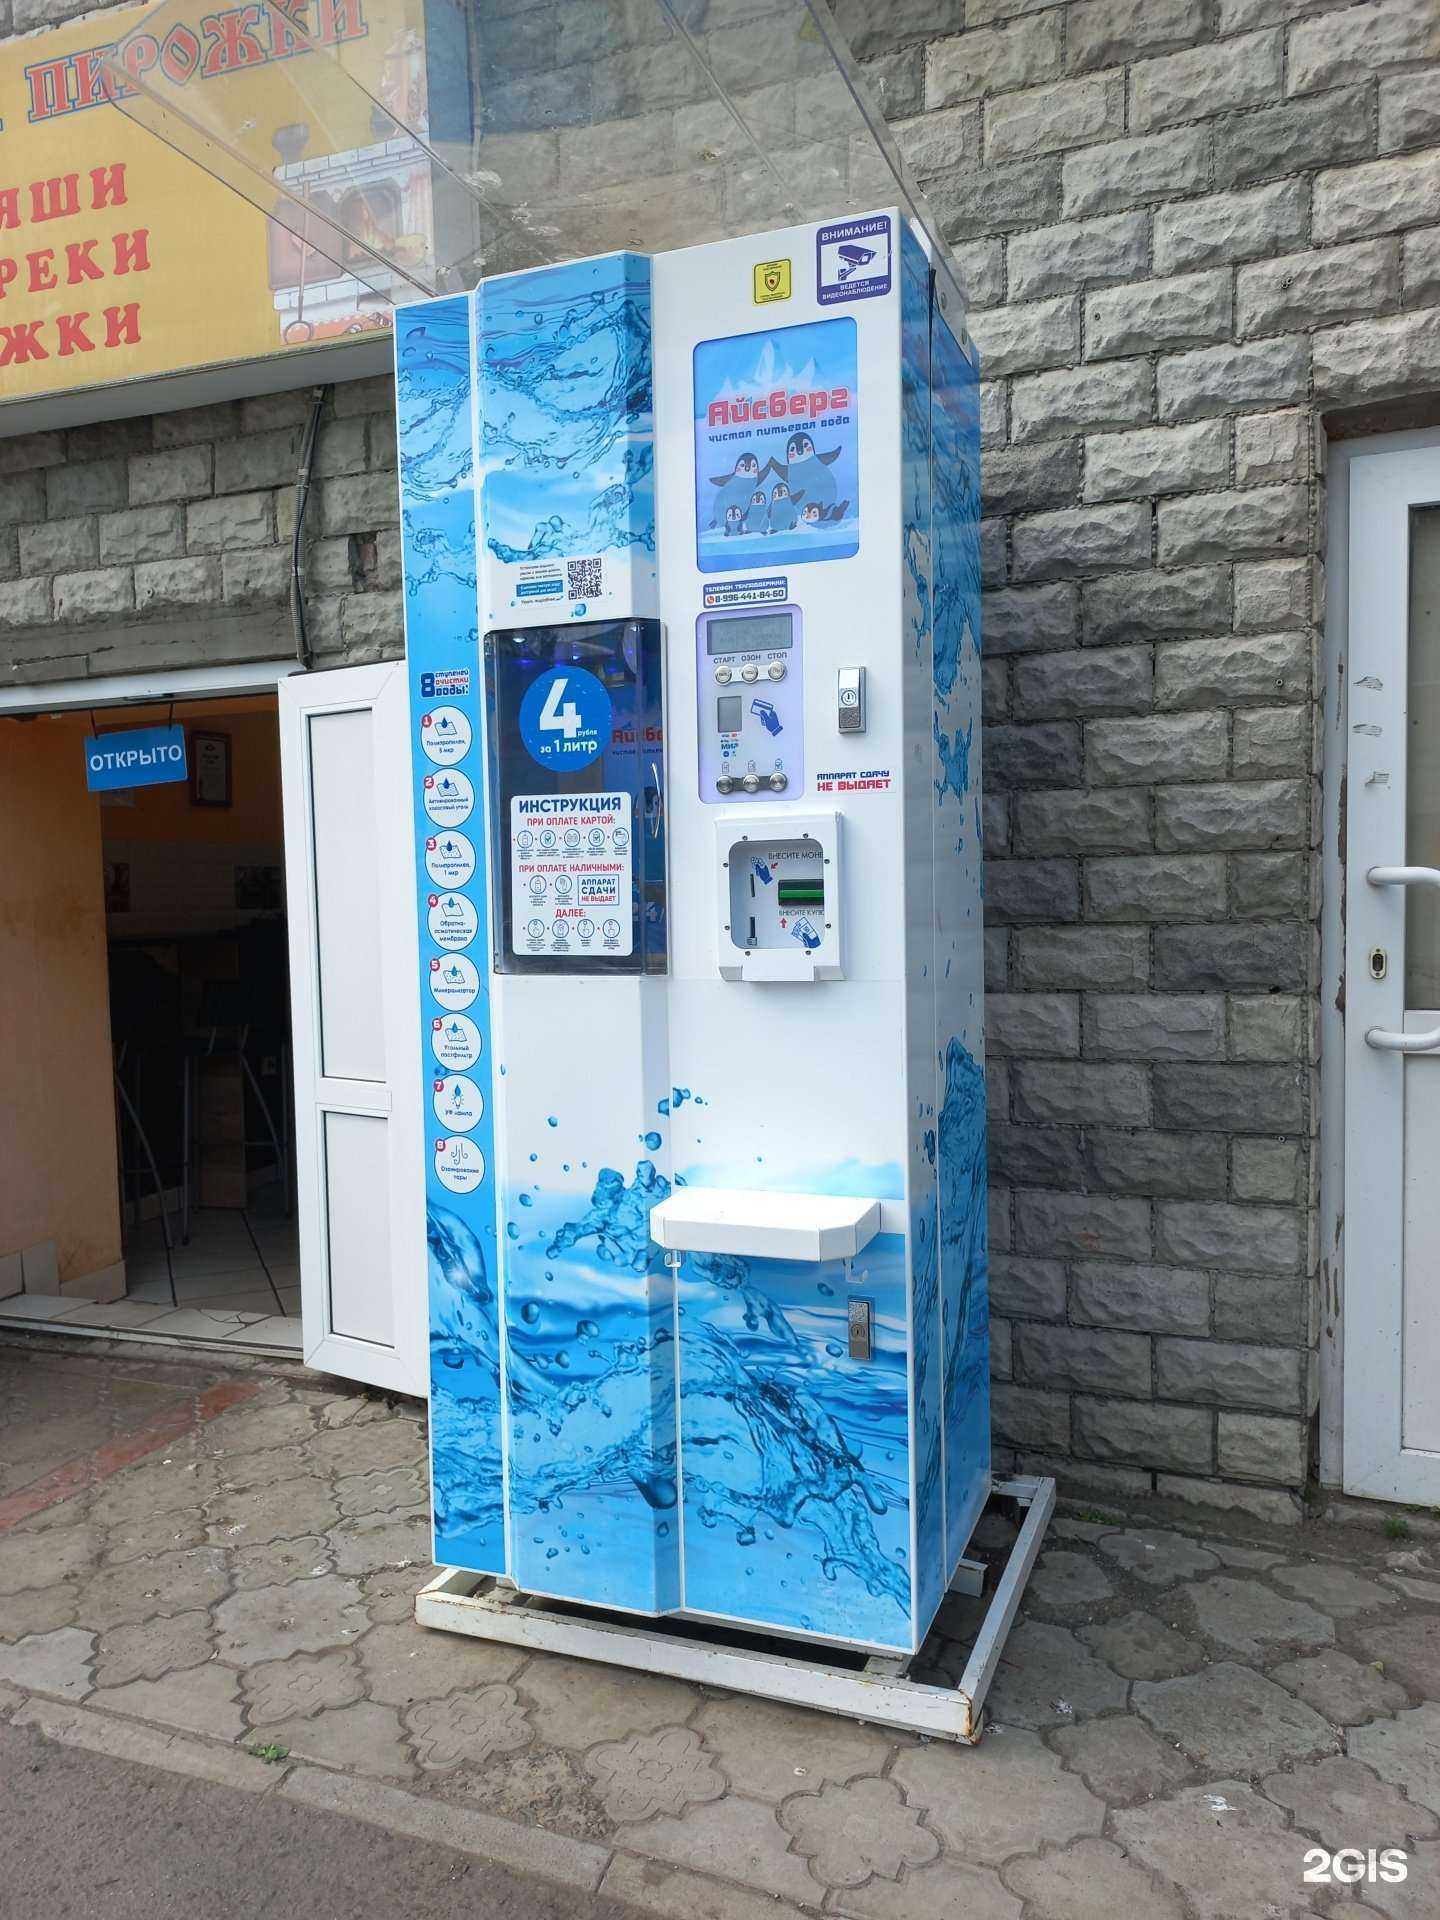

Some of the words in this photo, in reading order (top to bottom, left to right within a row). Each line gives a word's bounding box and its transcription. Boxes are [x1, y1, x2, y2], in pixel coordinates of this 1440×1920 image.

[25, 0, 369, 123] ПИРОЖКИ
[821, 221, 888, 241] ВНИМАНИЕ!
[822, 283, 888, 300] ВИДЕОНАБЛЮДЕНИЕ
[840, 280, 870, 291] ВЕДЕТСЯ
[0, 303, 141, 367] ЖКИ
[708, 387, 848, 427] Айсберг
[709, 430, 752, 443] чистая
[756, 420, 816, 437] питьевая
[821, 415, 850, 428] вода
[713, 656, 736, 664] СТАРТ
[741, 654, 761, 662] ОЗОН
[767, 651, 788, 660] СТОП
[420, 672, 436, 698] 8
[539, 678, 582, 739] 4
[577, 728, 598, 737] рубля
[539, 745, 552, 754] за
[553, 739, 561, 753] 1
[562, 739, 598, 755] литр
[90, 744, 183, 771] ОТКРЫТО
[816, 771, 857, 781] АППАРАТ
[860, 769, 890, 778] СДАЧУ
[817, 781, 833, 792] НЕ
[837, 779, 891, 791] ВЫДАЕТ
[519, 797, 622, 813] ИНСТРУКЦИЯ
[527, 817, 544, 826] ПРИ
[546, 816, 579, 826] ОПЛАТЕ
[580, 813, 616, 825] КАРТОЙ:
[768, 852, 800, 861] ВНЕСИТЕ
[519, 864, 535, 873] ПРИ
[537, 863, 567, 873] ОПЛАТЕ
[569, 862, 625, 872] НАЛИЧНЫМИ:
[581, 878, 616, 886] АППАРАТ
[581, 886, 616, 896] СДАЧИ
[590, 895, 616, 903] ВЫДАЕТ
[555, 908, 587, 918] ДАЛЕЕ:
